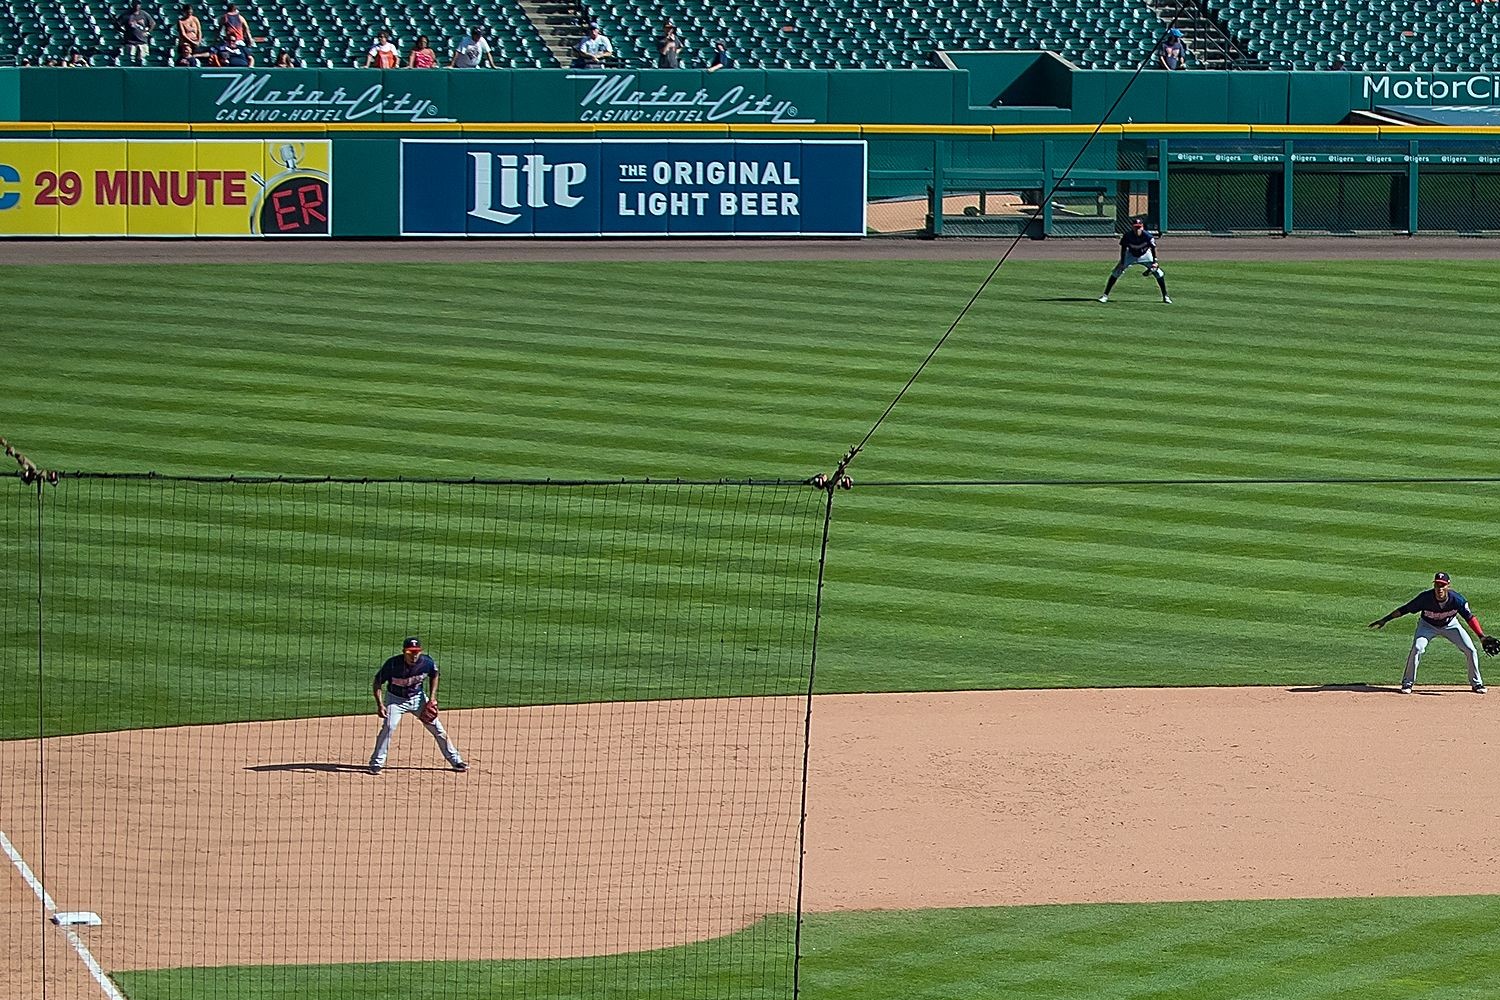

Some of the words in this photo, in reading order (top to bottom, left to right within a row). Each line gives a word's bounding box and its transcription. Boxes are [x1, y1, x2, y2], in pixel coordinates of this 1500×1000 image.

[289, 109, 341, 121] HOTEL
[652, 110, 703, 122] HOTEL
[1177, 154, 1203, 163] @tigers
[1215, 154, 1241, 163] @tigers
[1252, 154, 1278, 163] @tigers
[1290, 154, 1316, 163] @tigers
[1328, 155, 1354, 164] @tigers
[1366, 155, 1392, 164] @tigers
[1403, 155, 1429, 164] @tigers
[1441, 155, 1467, 164] @tigers
[619, 164, 647, 177] THE
[653, 161, 800, 185] ORIGINAL
[34, 170, 83, 206] 29
[95, 170, 248, 206] MINUTE
[467, 151, 587, 225] Lite
[272, 183, 327, 231] ER
[618, 192, 709, 216] LIGHT
[720, 192, 800, 216] BEER
